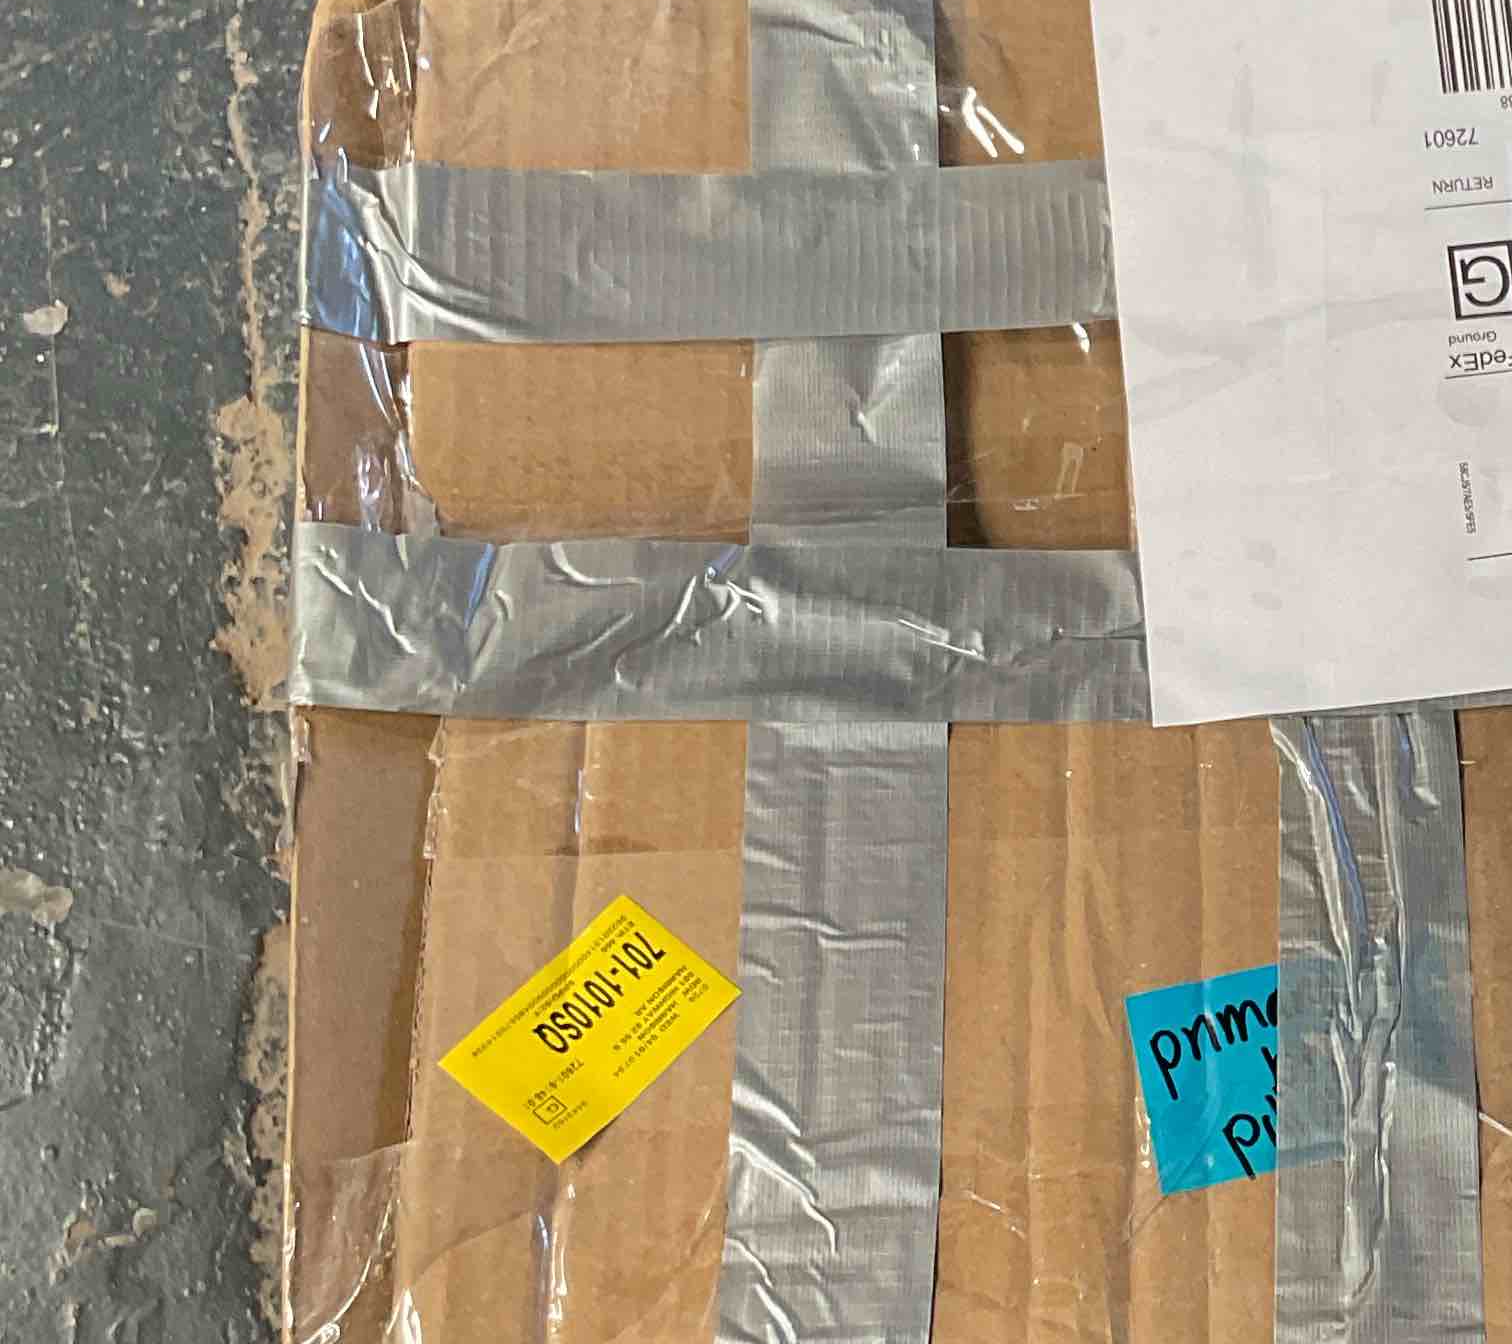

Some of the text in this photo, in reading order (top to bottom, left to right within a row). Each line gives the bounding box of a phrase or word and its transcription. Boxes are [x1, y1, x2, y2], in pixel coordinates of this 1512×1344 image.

[1424, 127, 1479, 149] 72601
[1432, 176, 1494, 193] RETURN
[1459, 251, 1510, 307] G
[1448, 330, 1497, 347] Ground
[532, 931, 667, 1054] 701-1010SQ
